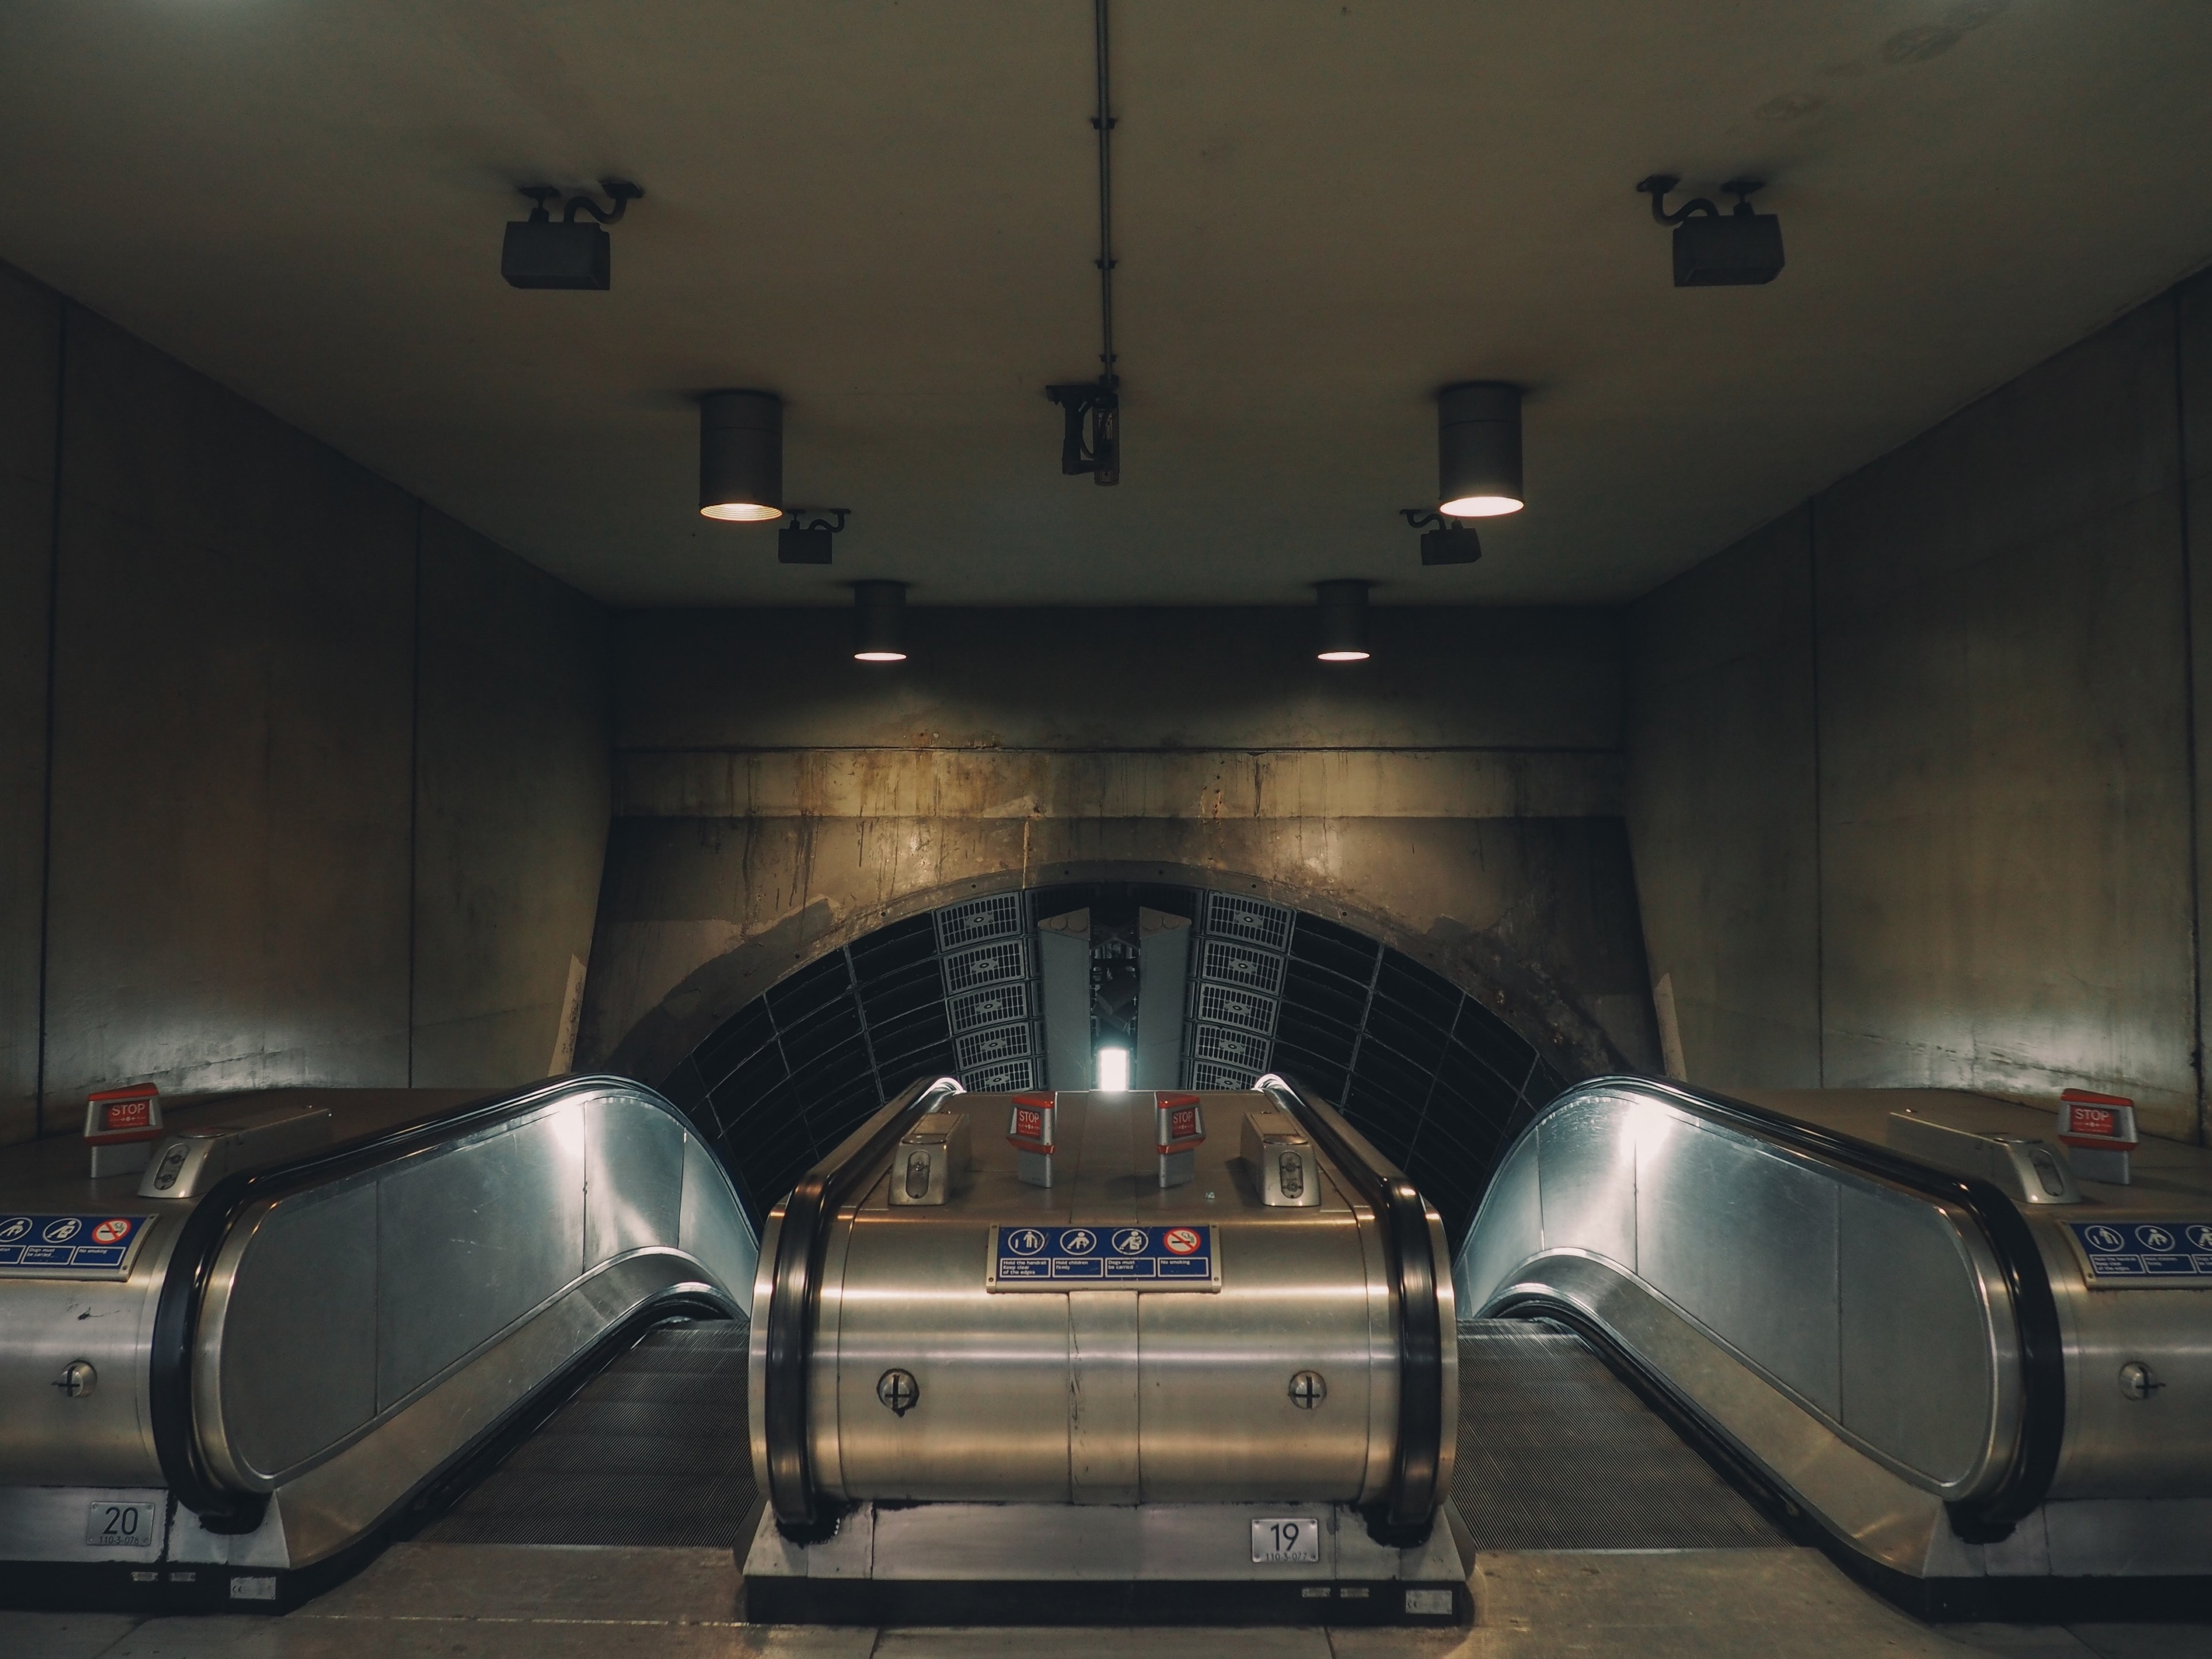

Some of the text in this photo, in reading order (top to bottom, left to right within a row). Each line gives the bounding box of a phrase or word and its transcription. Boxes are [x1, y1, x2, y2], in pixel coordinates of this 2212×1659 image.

[112, 1103, 145, 1116] STOP
[2075, 1108, 2109, 1120] STOP
[1019, 1111, 1039, 1123] STOP
[1173, 1111, 1193, 1123] STOP
[103, 1507, 138, 1535] 20
[1270, 1523, 1299, 1551] 19
